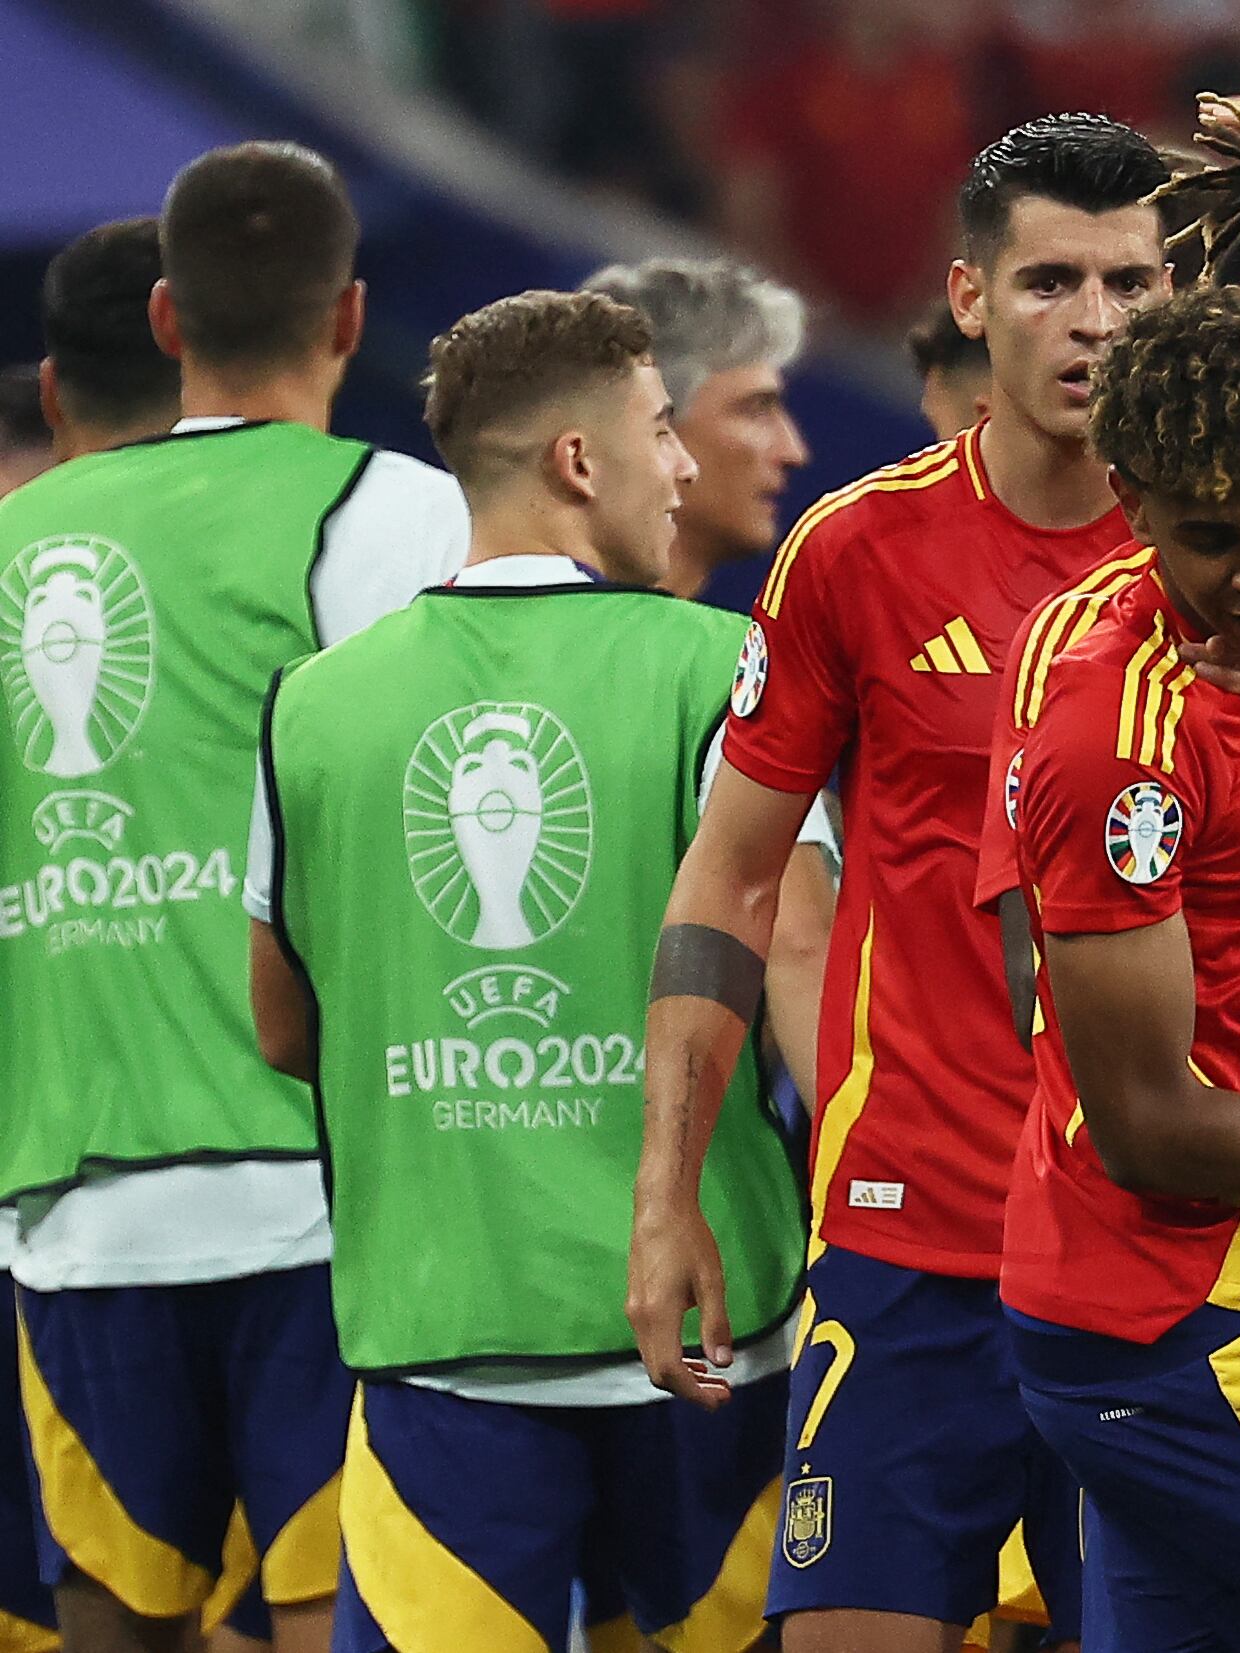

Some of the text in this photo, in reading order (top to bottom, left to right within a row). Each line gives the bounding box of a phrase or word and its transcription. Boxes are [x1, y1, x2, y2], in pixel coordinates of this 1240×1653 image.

[0, 848, 238, 938] EURO2024
[47, 915, 167, 955] ERMANY
[449, 976, 560, 1019] UEFA
[432, 1098, 602, 1132] GERMANY
[797, 1319, 857, 1450] 7
